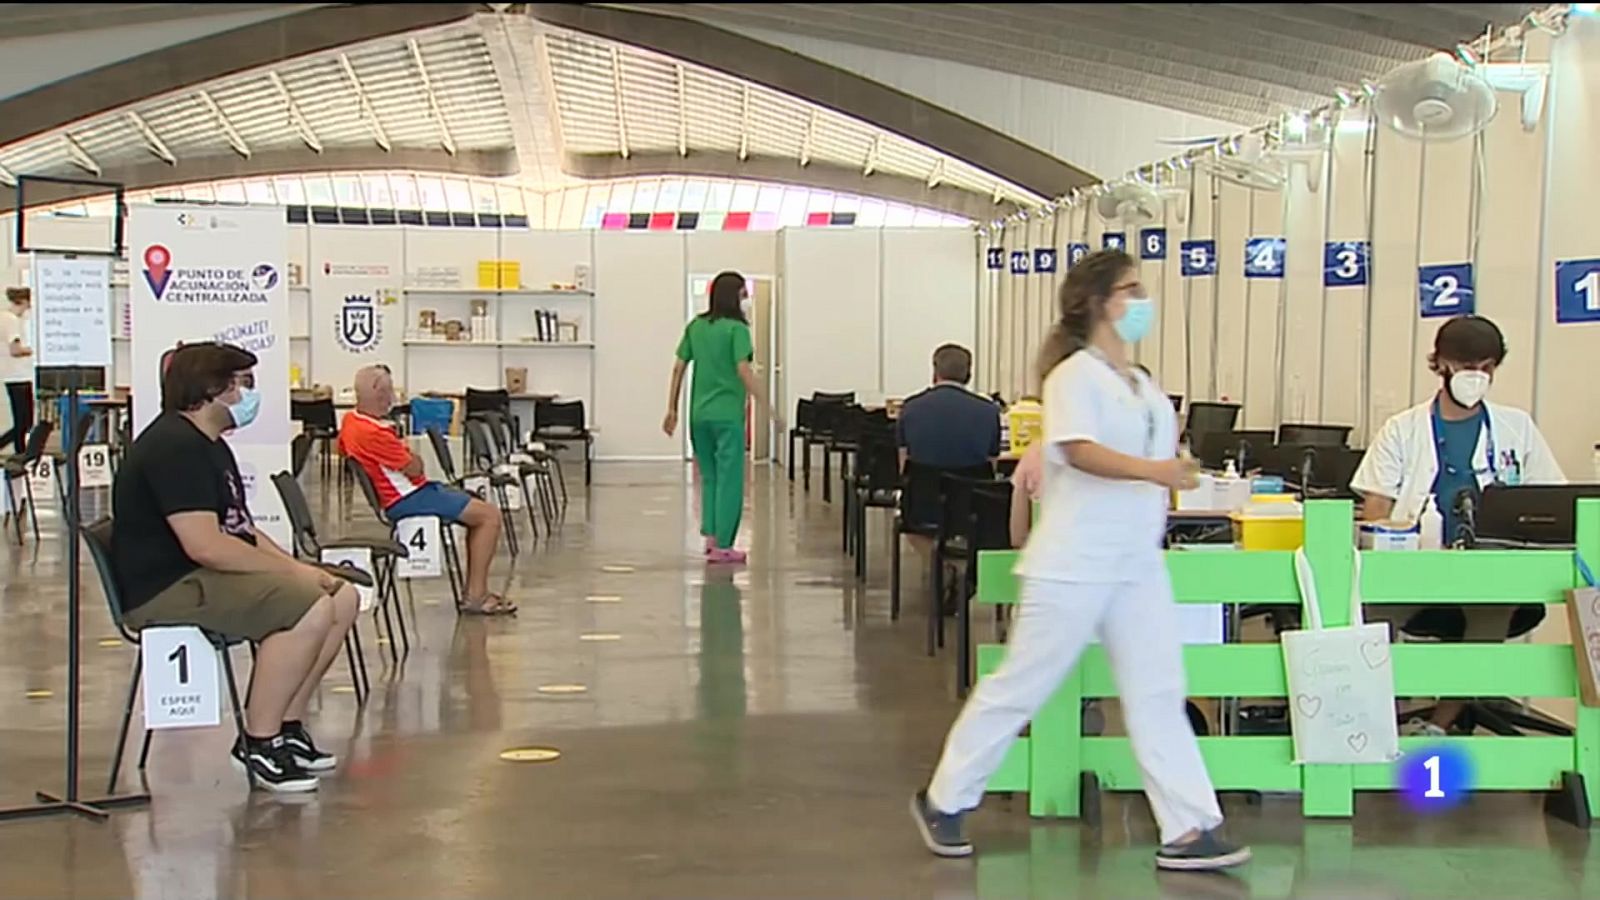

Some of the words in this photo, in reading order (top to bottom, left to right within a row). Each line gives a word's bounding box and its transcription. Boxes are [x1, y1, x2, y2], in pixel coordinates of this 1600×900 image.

[1146, 235, 1161, 254] 6
[988, 252, 1004, 266] 11
[1012, 257, 1029, 271] 10
[1039, 253, 1053, 269] 9
[1189, 248, 1207, 268] 5
[1254, 249, 1275, 271] 4
[1335, 250, 1359, 279] 3
[177, 269, 224, 280] PUNTO
[227, 269, 244, 280] DE
[165, 292, 269, 303] CENTRALIZADA
[1433, 274, 1461, 307] 2
[1574, 271, 1600, 311] 1
[83, 451, 105, 468] 19
[409, 525, 428, 552] 4
[168, 644, 190, 686] 1
[160, 693, 202, 706] ESPERE
